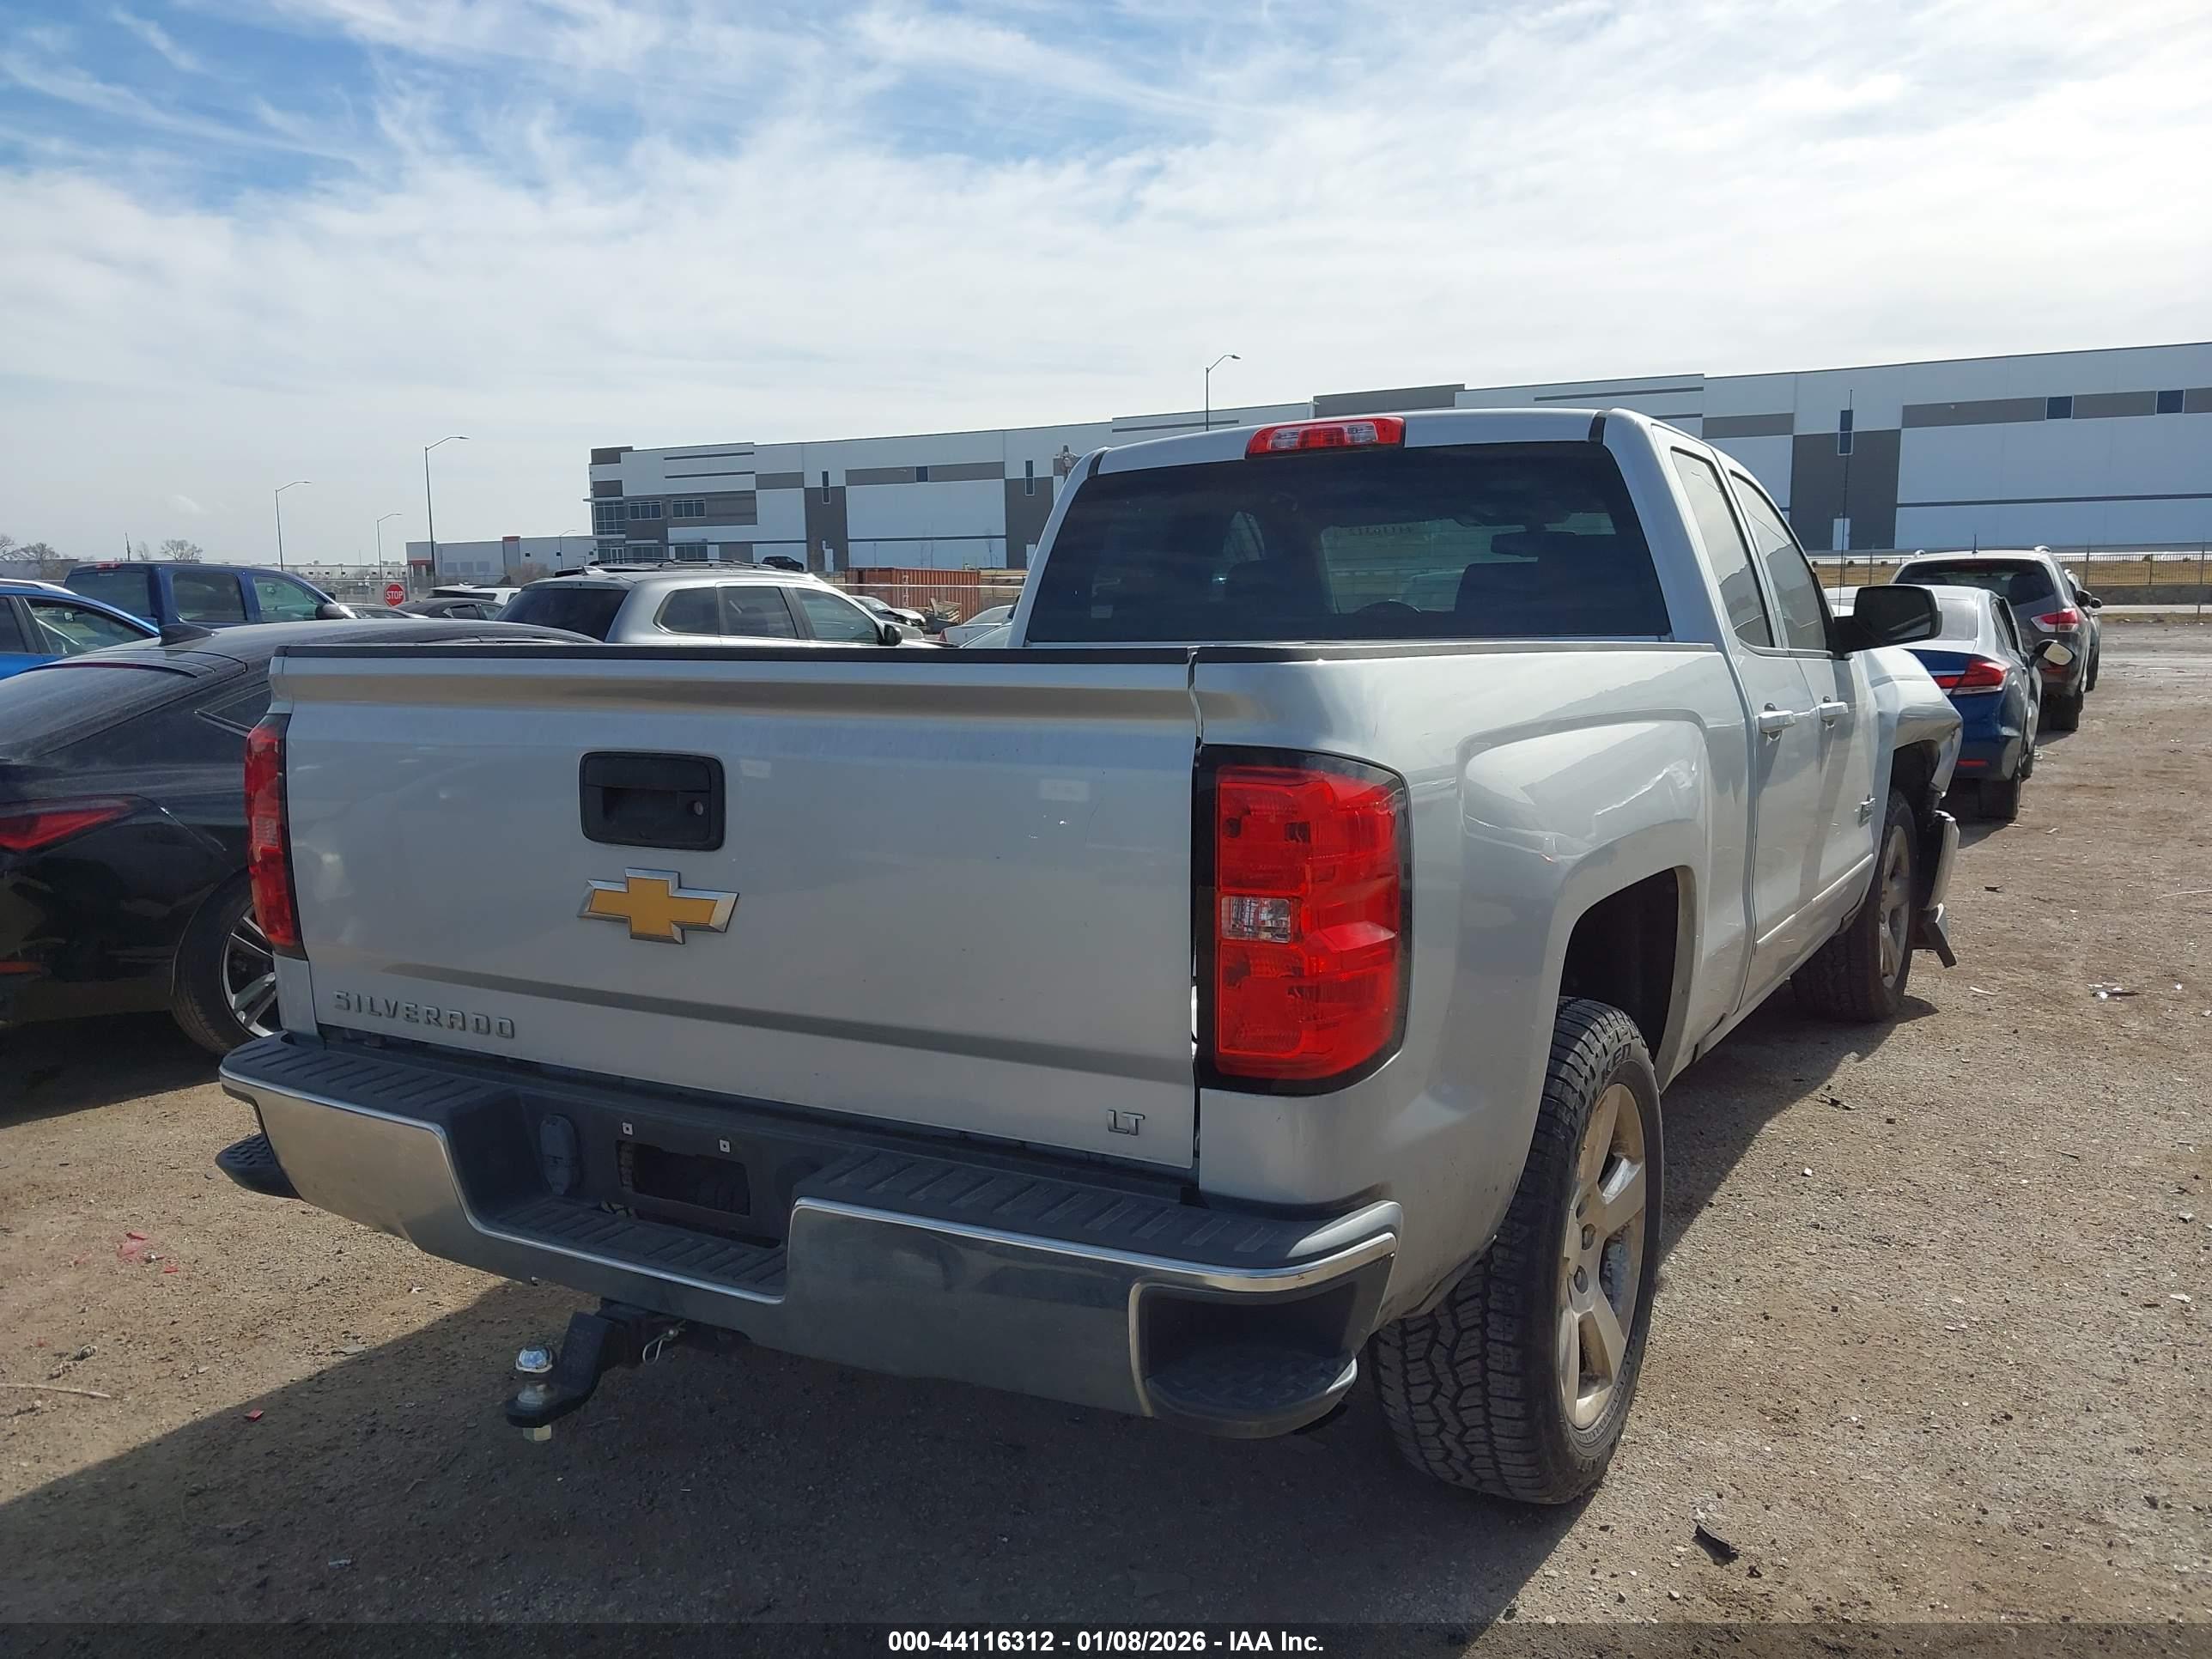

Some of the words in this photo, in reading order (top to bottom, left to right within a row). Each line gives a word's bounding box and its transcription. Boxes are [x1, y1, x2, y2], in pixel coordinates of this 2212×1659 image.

[386, 591, 404, 599] STOP
[333, 990, 515, 1038] SILVERADO
[1106, 1109, 1146, 1136] LT
